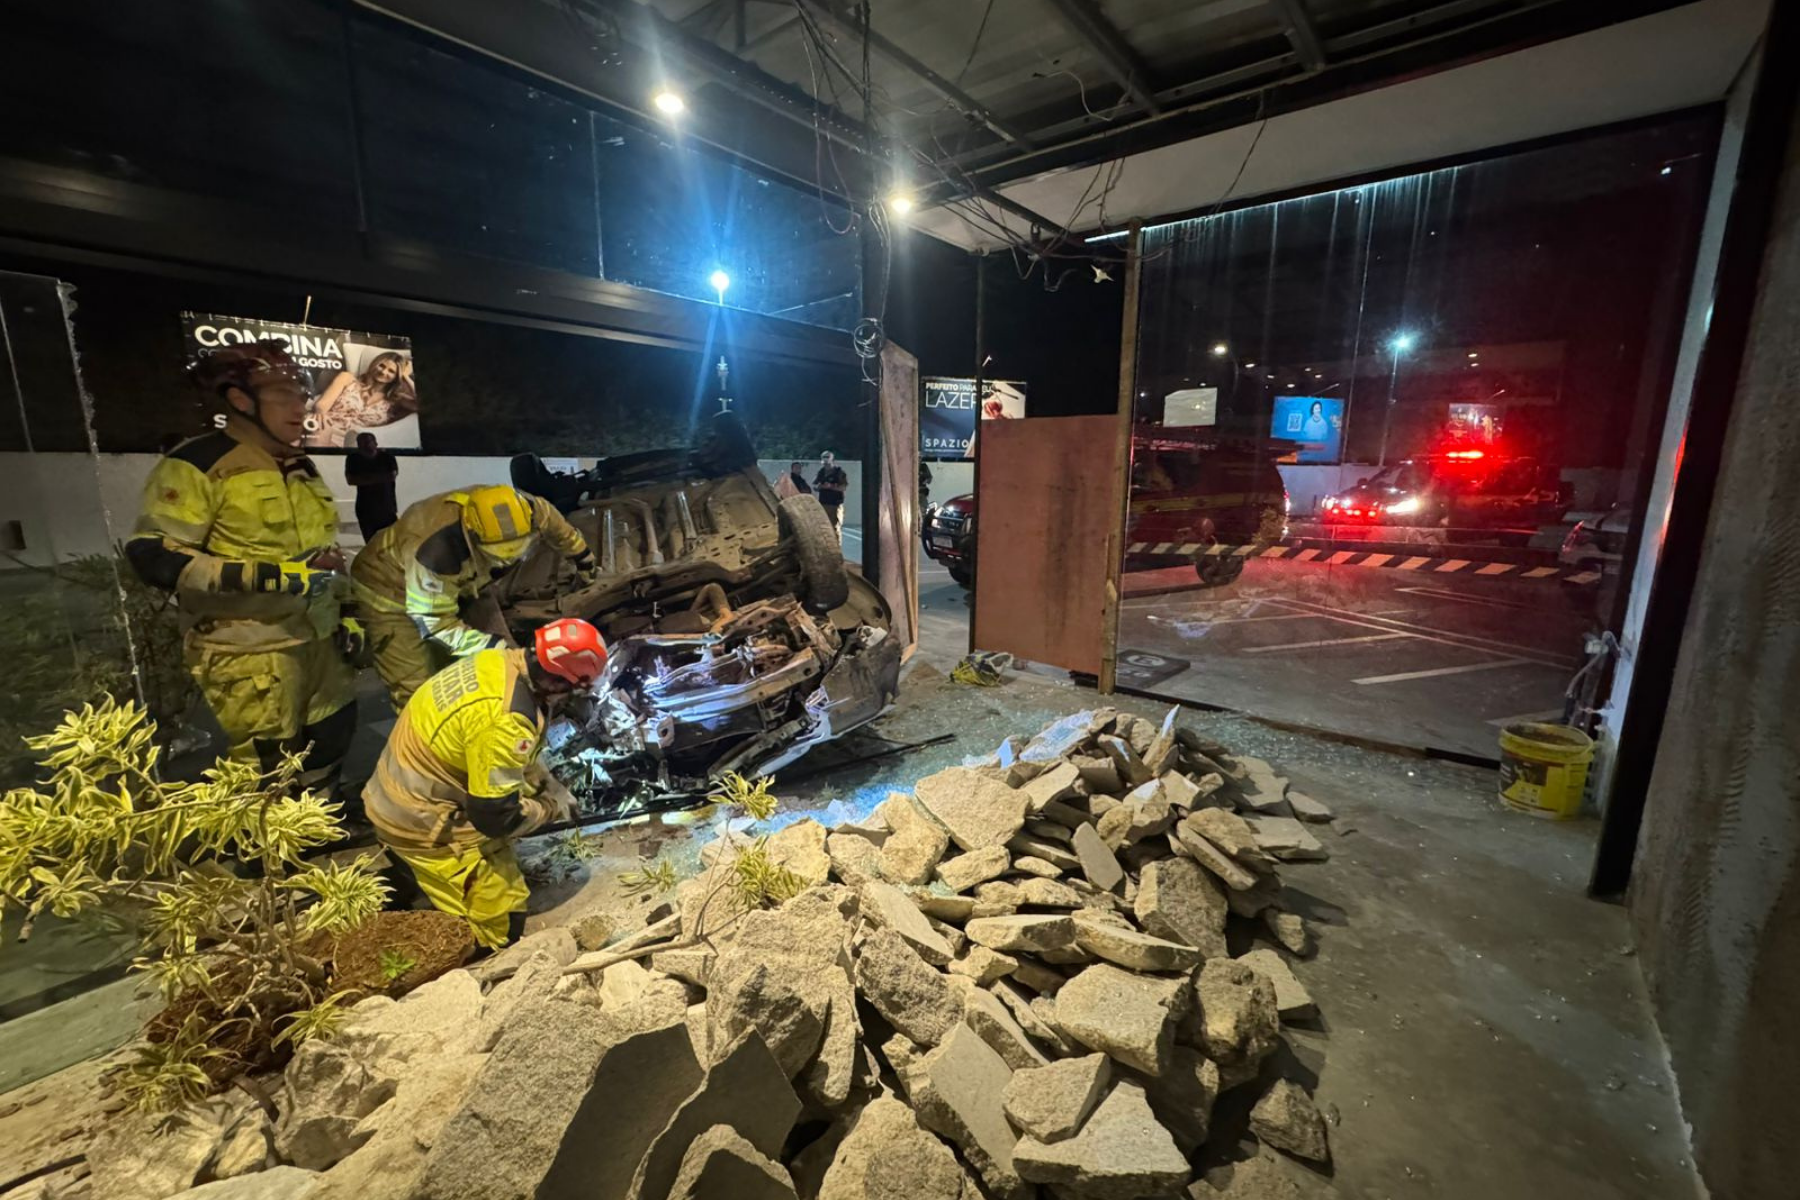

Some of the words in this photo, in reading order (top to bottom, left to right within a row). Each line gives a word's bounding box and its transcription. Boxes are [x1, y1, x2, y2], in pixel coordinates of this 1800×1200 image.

[299, 356, 342, 369] GOSTO
[925, 382, 958, 391] PERFEITO
[925, 438, 970, 448] SPAZIO
